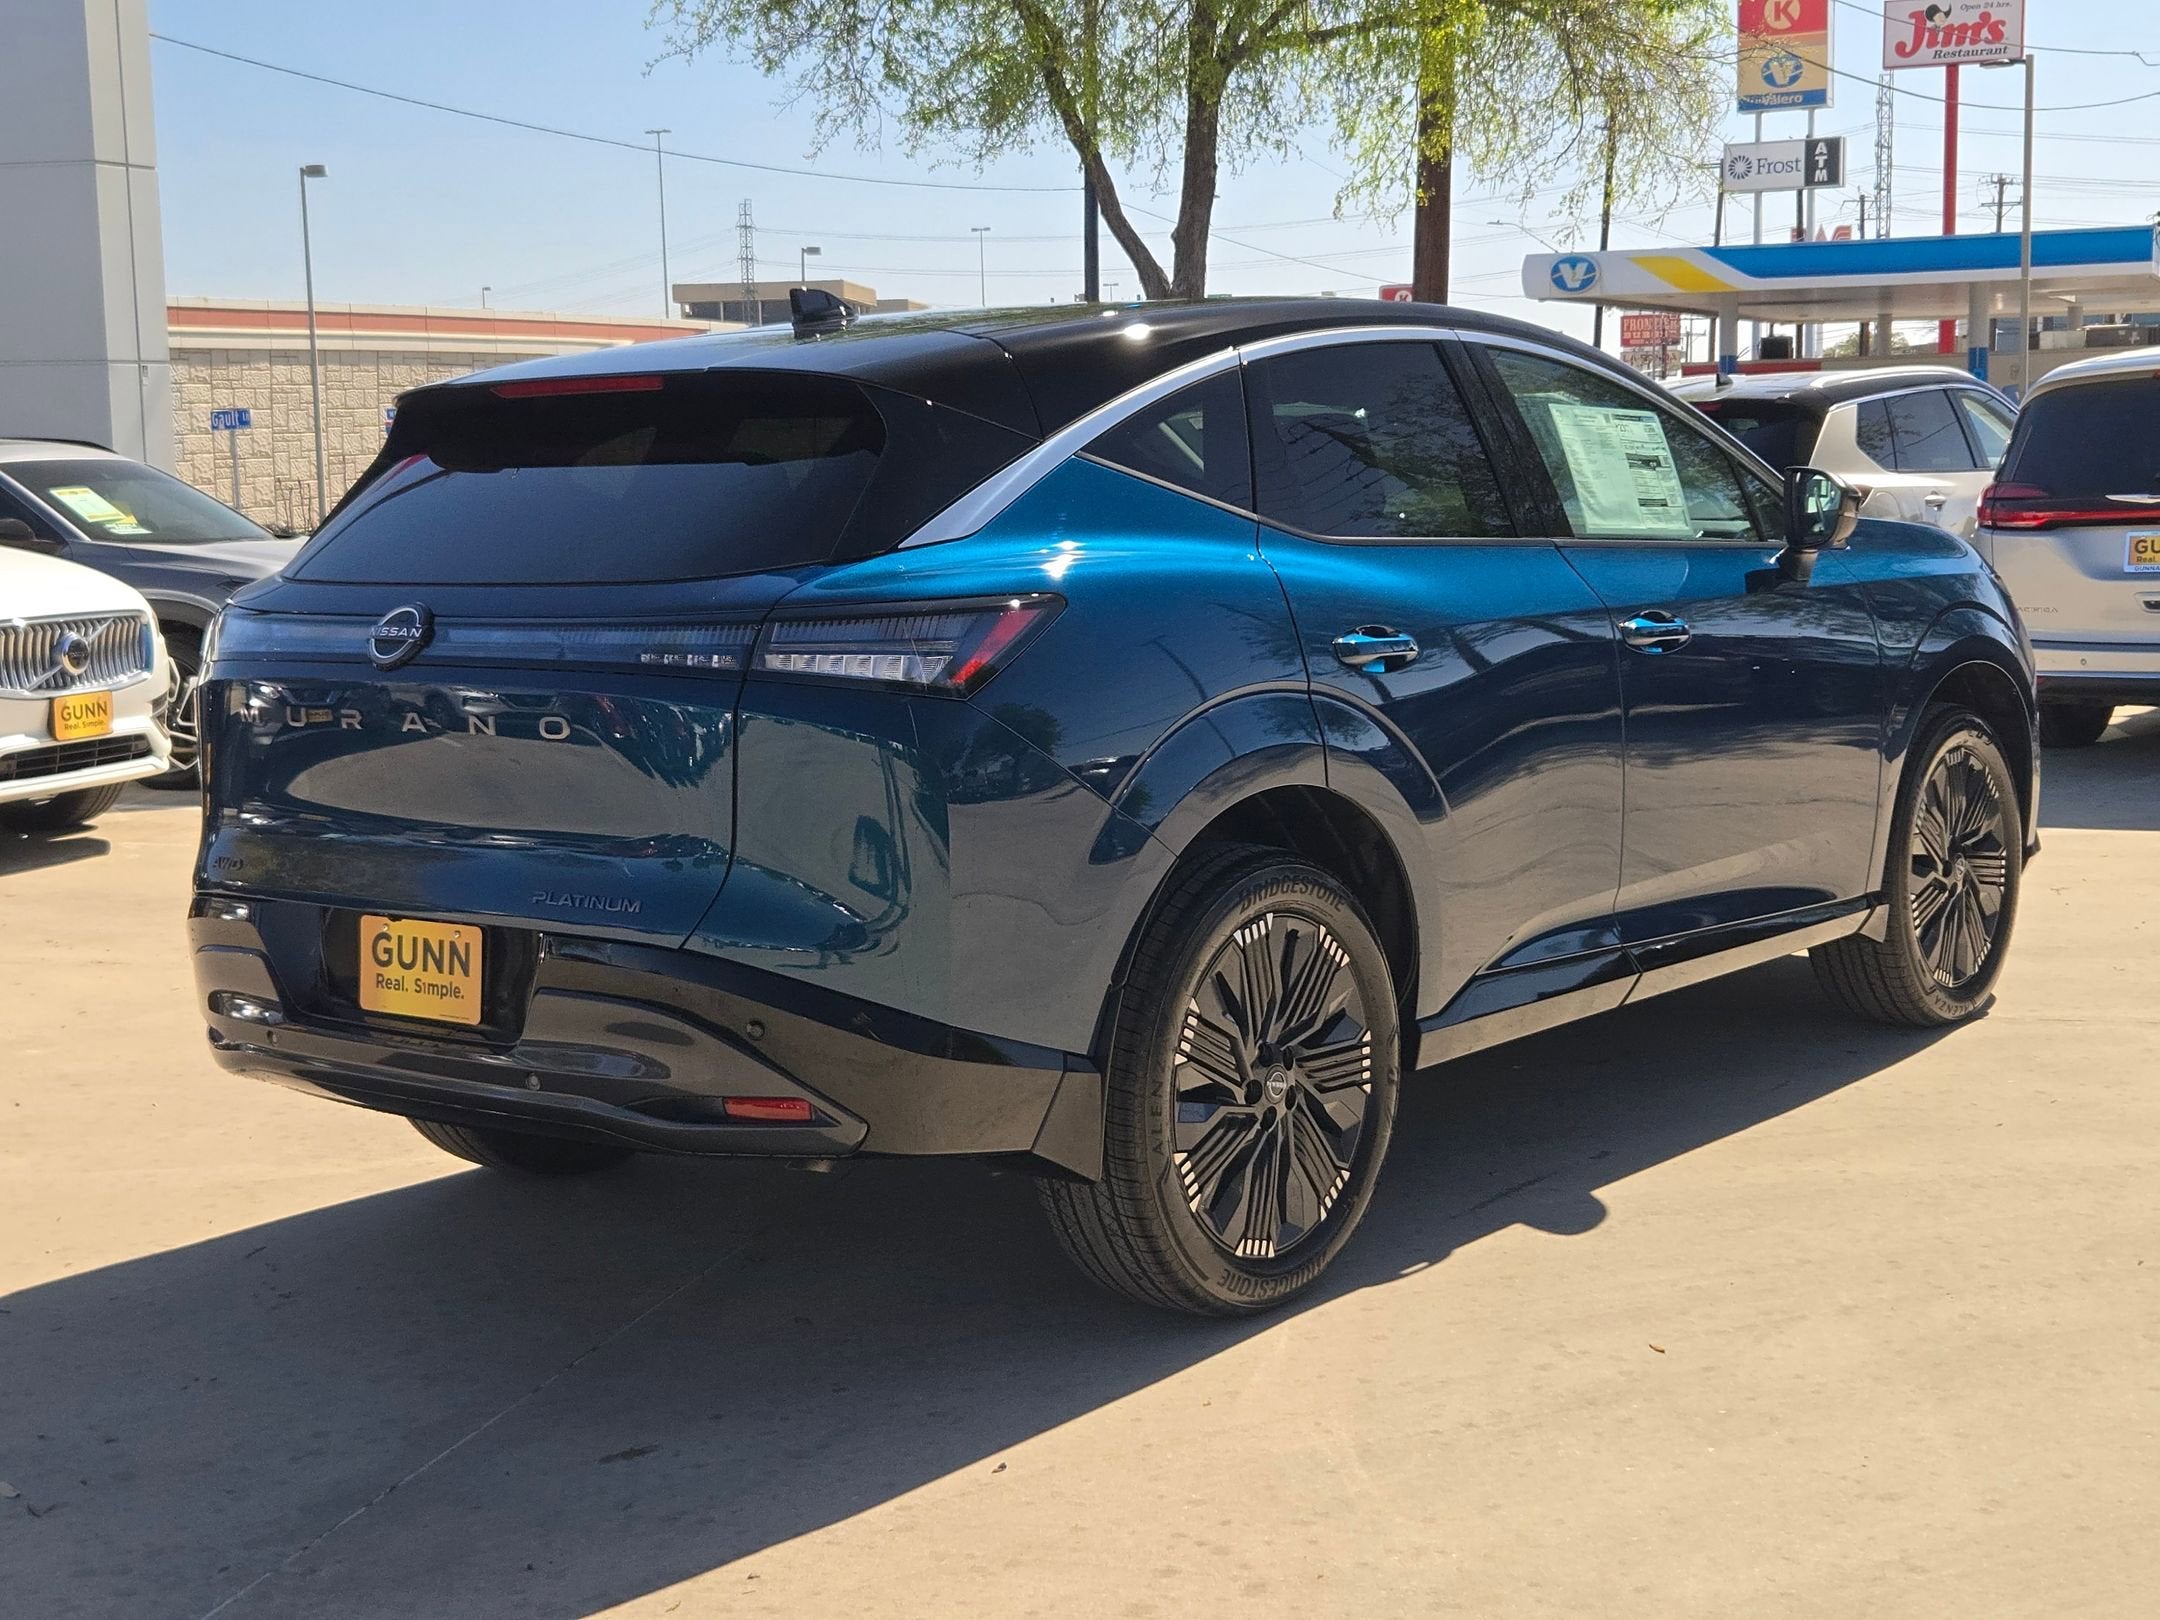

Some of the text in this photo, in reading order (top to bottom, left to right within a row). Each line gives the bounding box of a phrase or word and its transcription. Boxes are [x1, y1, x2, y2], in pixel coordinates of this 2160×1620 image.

[1960, 3, 1982, 11] Open
[1895, 9, 2006, 58] Jim's
[1932, 46, 2008, 60] Restaurant
[1755, 157, 1801, 175] Frost
[1814, 142, 1828, 182] ATM
[212, 411, 240, 427] Gault
[370, 627, 422, 638] NISSAN
[61, 701, 108, 722] GUNN
[240, 704, 571, 740] MURANO
[532, 890, 643, 913] PLATINUM
[372, 931, 470, 977] GUNN
[376, 973, 464, 1000] Real. Simple.
